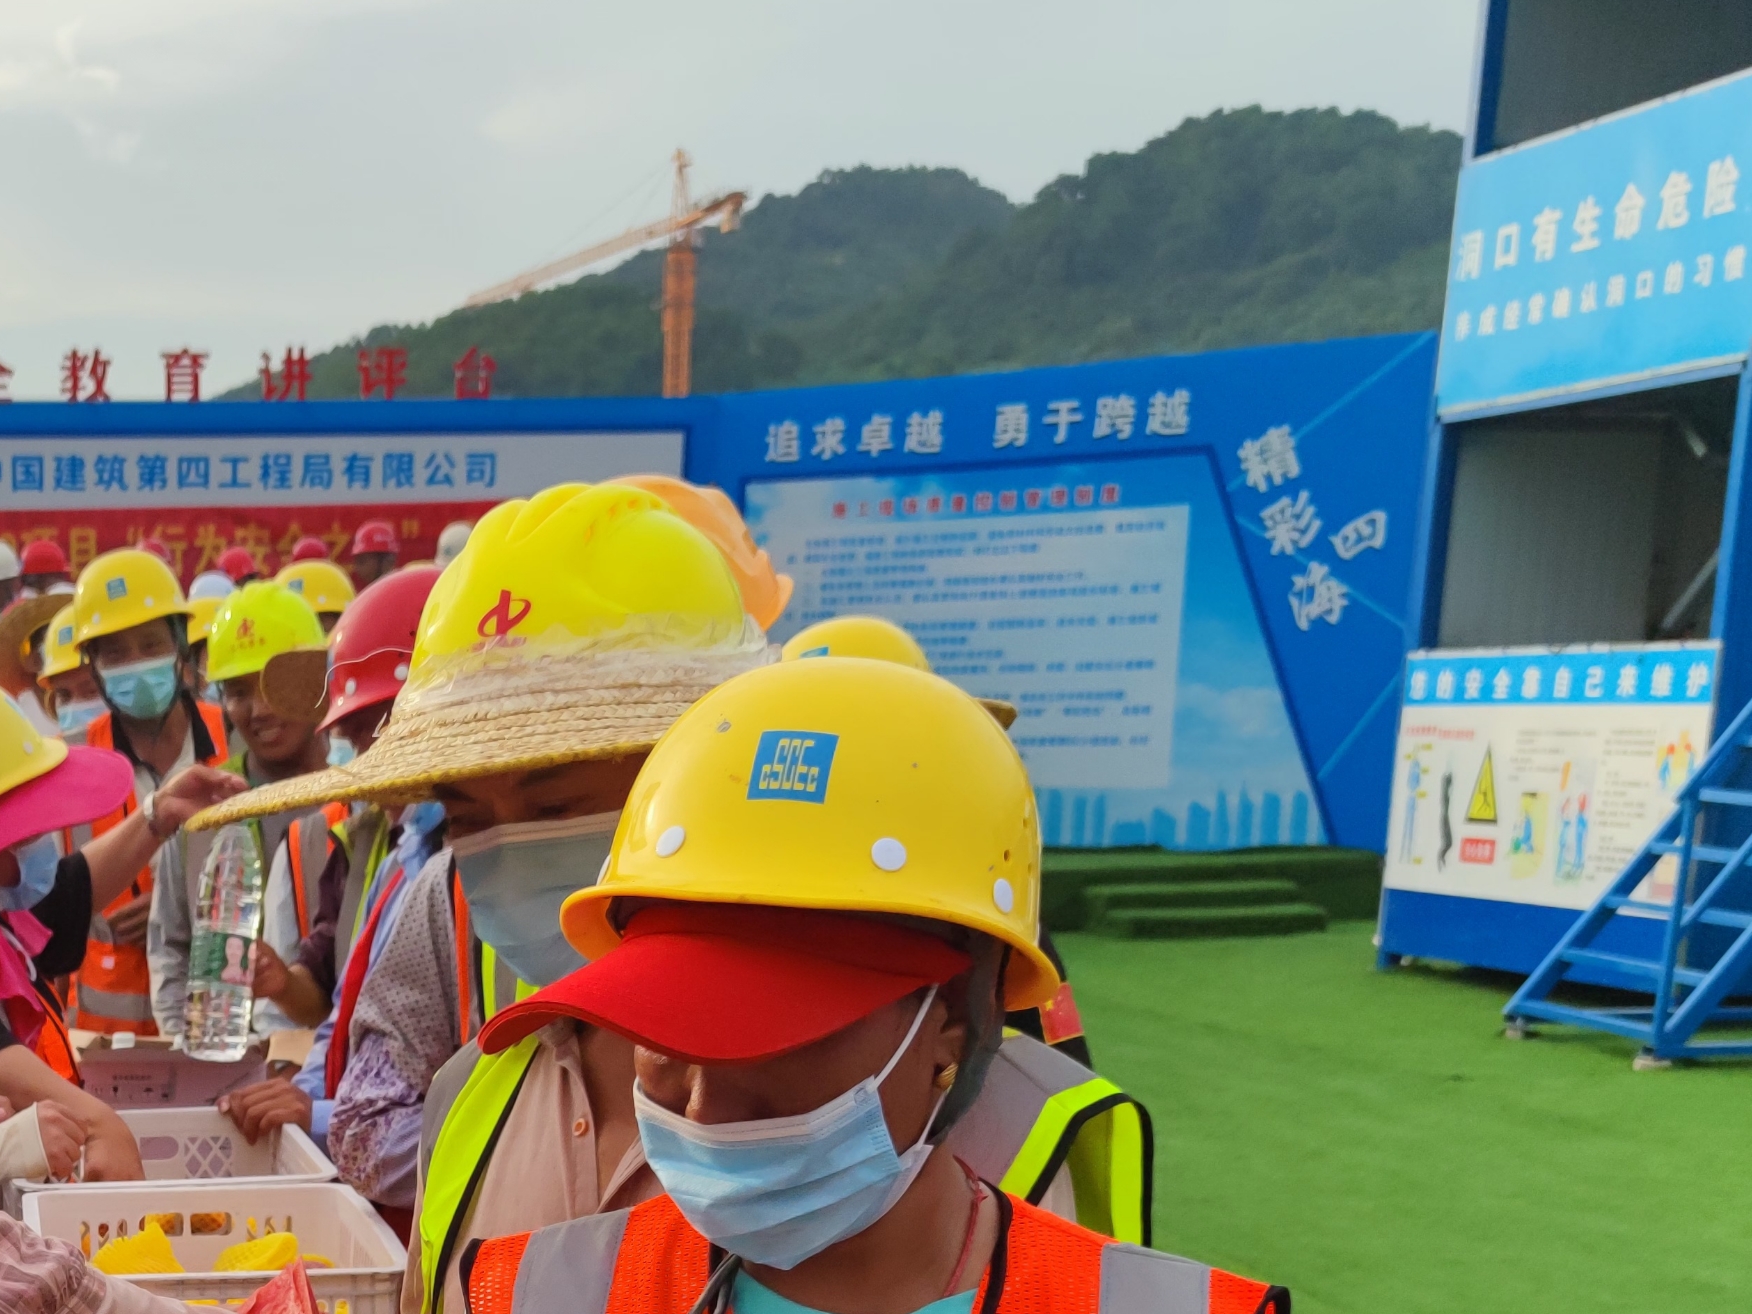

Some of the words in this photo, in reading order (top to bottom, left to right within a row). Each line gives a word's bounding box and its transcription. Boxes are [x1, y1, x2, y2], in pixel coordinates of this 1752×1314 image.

[764, 410, 944, 464] 追求卓越
[992, 390, 1192, 449] 勇于跨越
